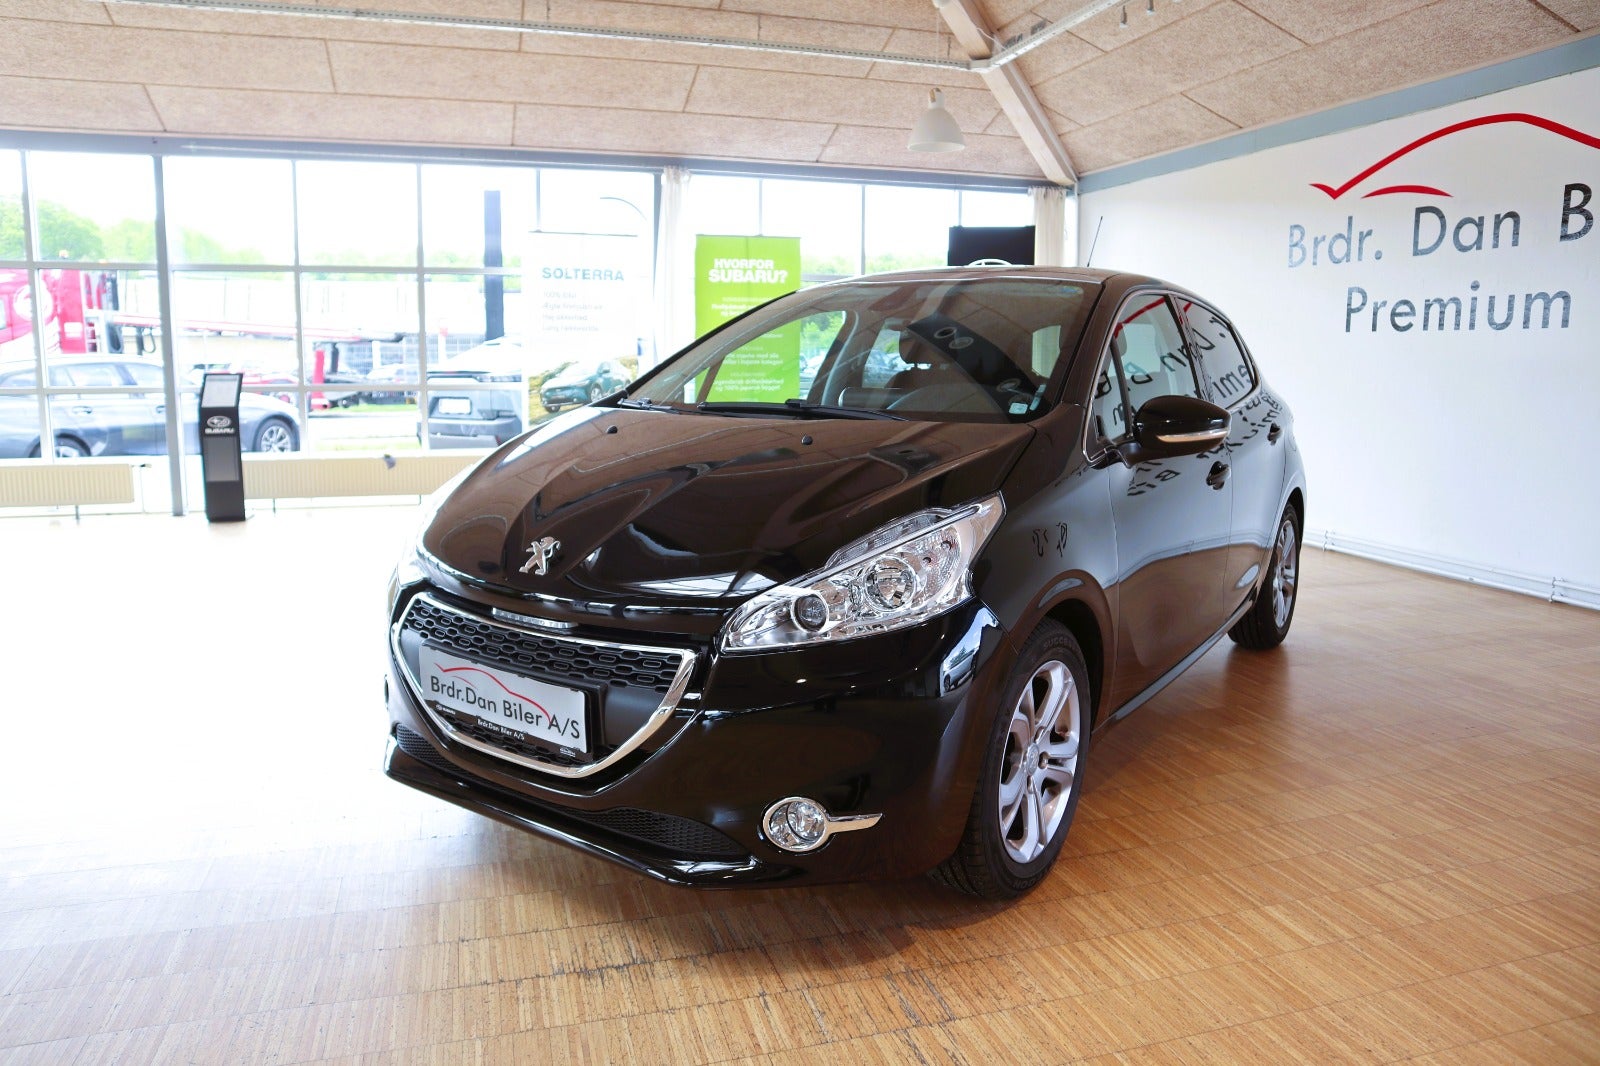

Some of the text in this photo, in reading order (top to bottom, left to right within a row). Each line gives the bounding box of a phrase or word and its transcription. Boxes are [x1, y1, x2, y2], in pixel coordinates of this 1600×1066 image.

[1288, 215, 1383, 268] Brdr.
[1412, 205, 1521, 257] Dan
[541, 266, 625, 281] SOLTERRA
[708, 269, 788, 284] SUBARU?
[714, 258, 774, 269] HVORFOR
[1345, 280, 1572, 333] Premium
[502, 700, 543, 727] Biler
[547, 714, 580, 739] A/S
